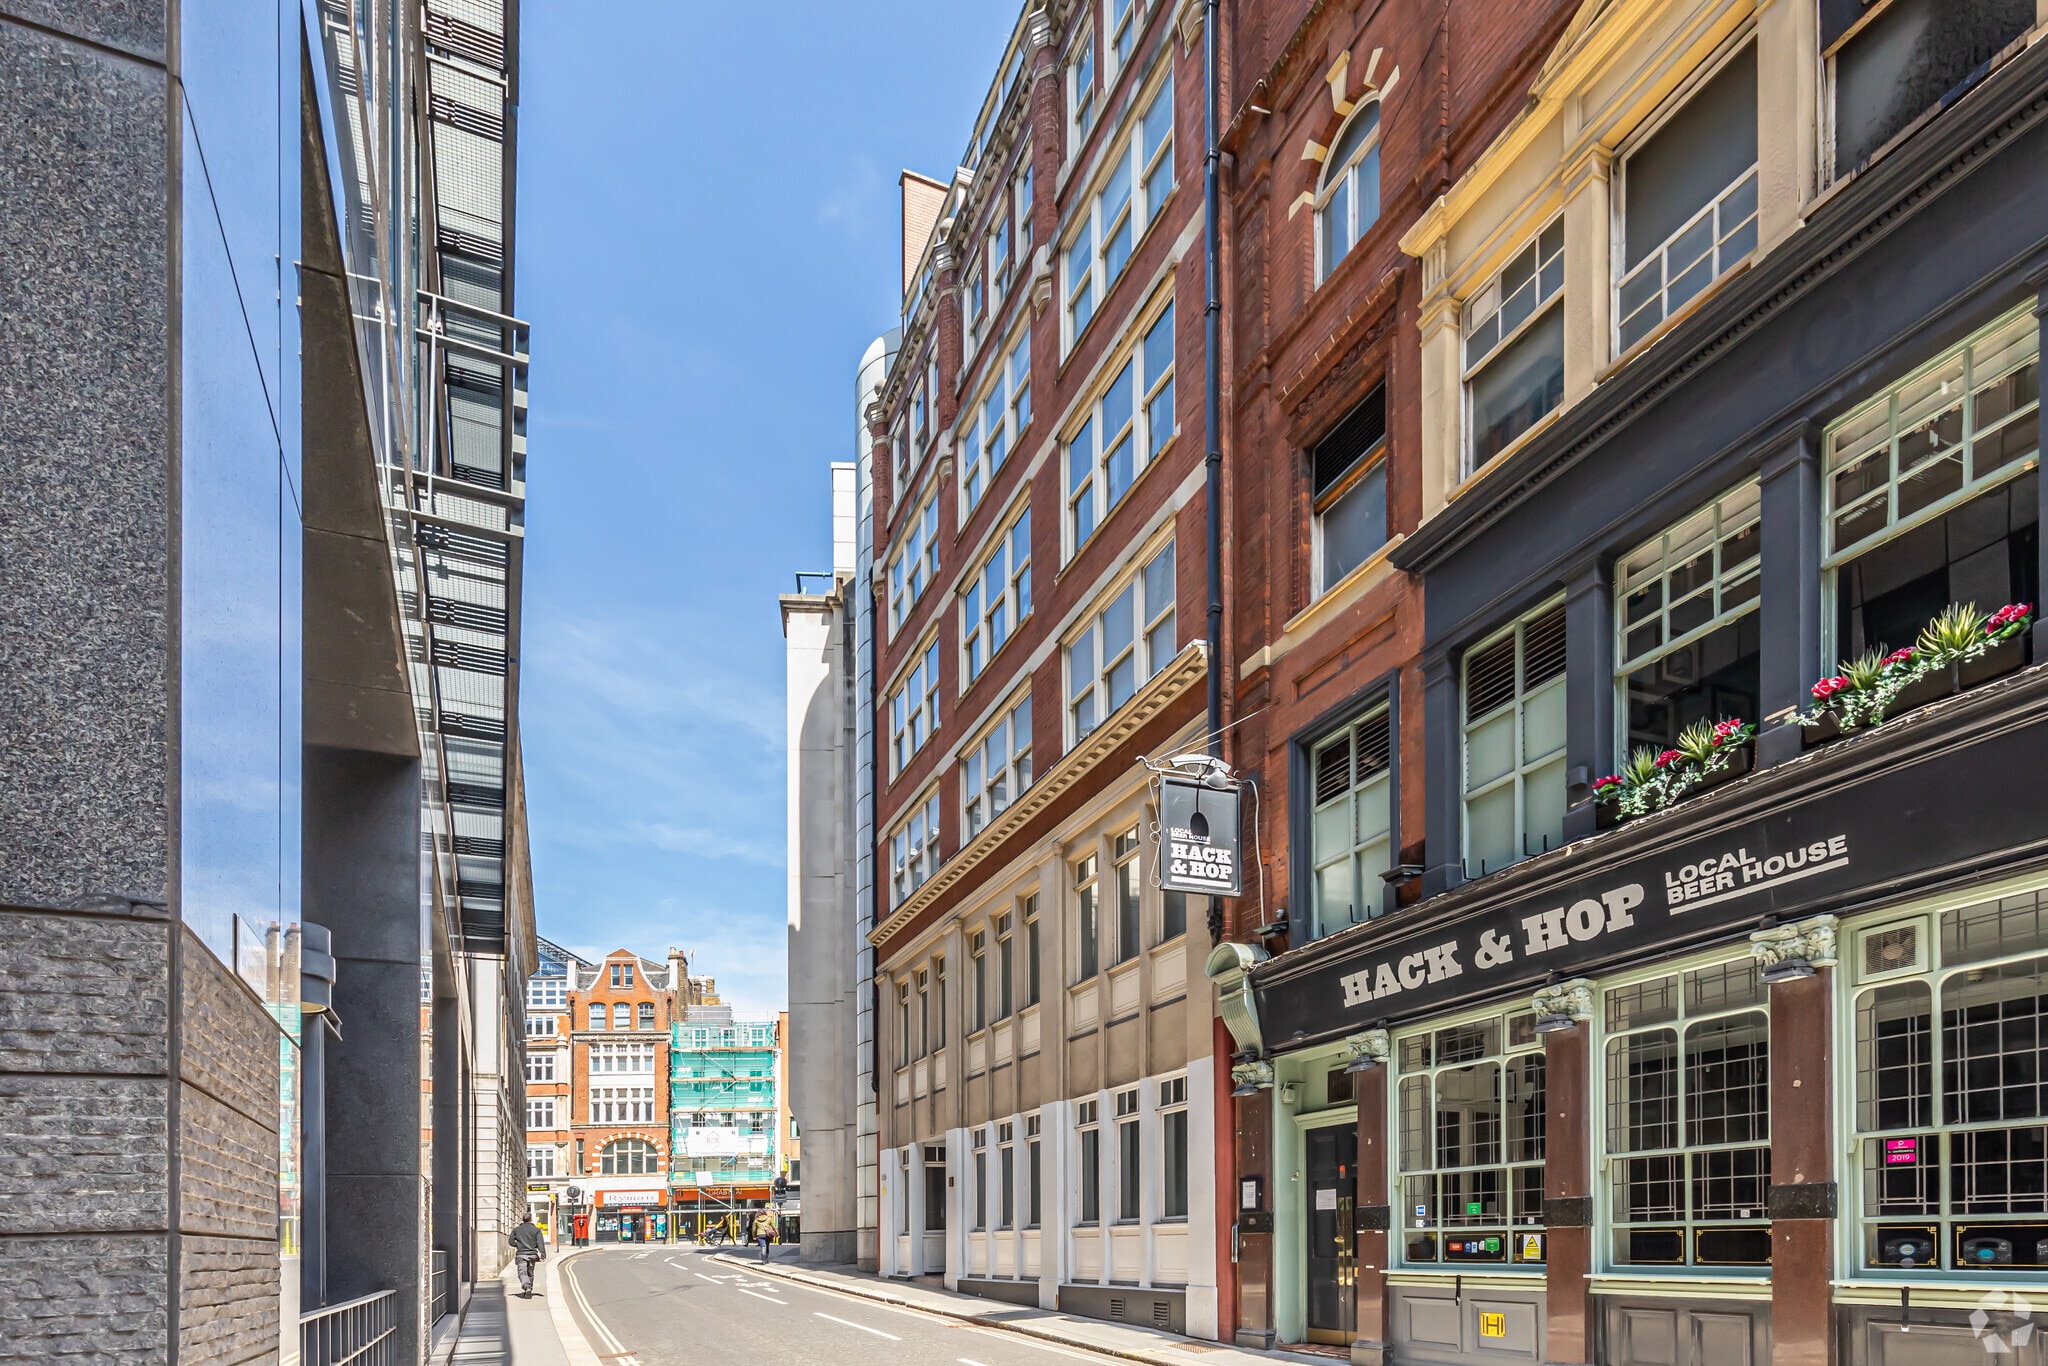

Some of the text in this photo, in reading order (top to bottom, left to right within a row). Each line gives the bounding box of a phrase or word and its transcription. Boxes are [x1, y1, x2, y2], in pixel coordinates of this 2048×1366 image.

[1171, 827, 1191, 835] LOCAL
[1189, 833, 1211, 842] HOUSE
[1171, 842, 1232, 865] HACK
[1170, 859, 1232, 880] & HOP
[1665, 848, 1757, 888] LOCAL
[1667, 834, 1848, 905] BEER HOUSE
[1340, 883, 1645, 1008] HACK & HOP
[1486, 1315, 1500, 1335] H
